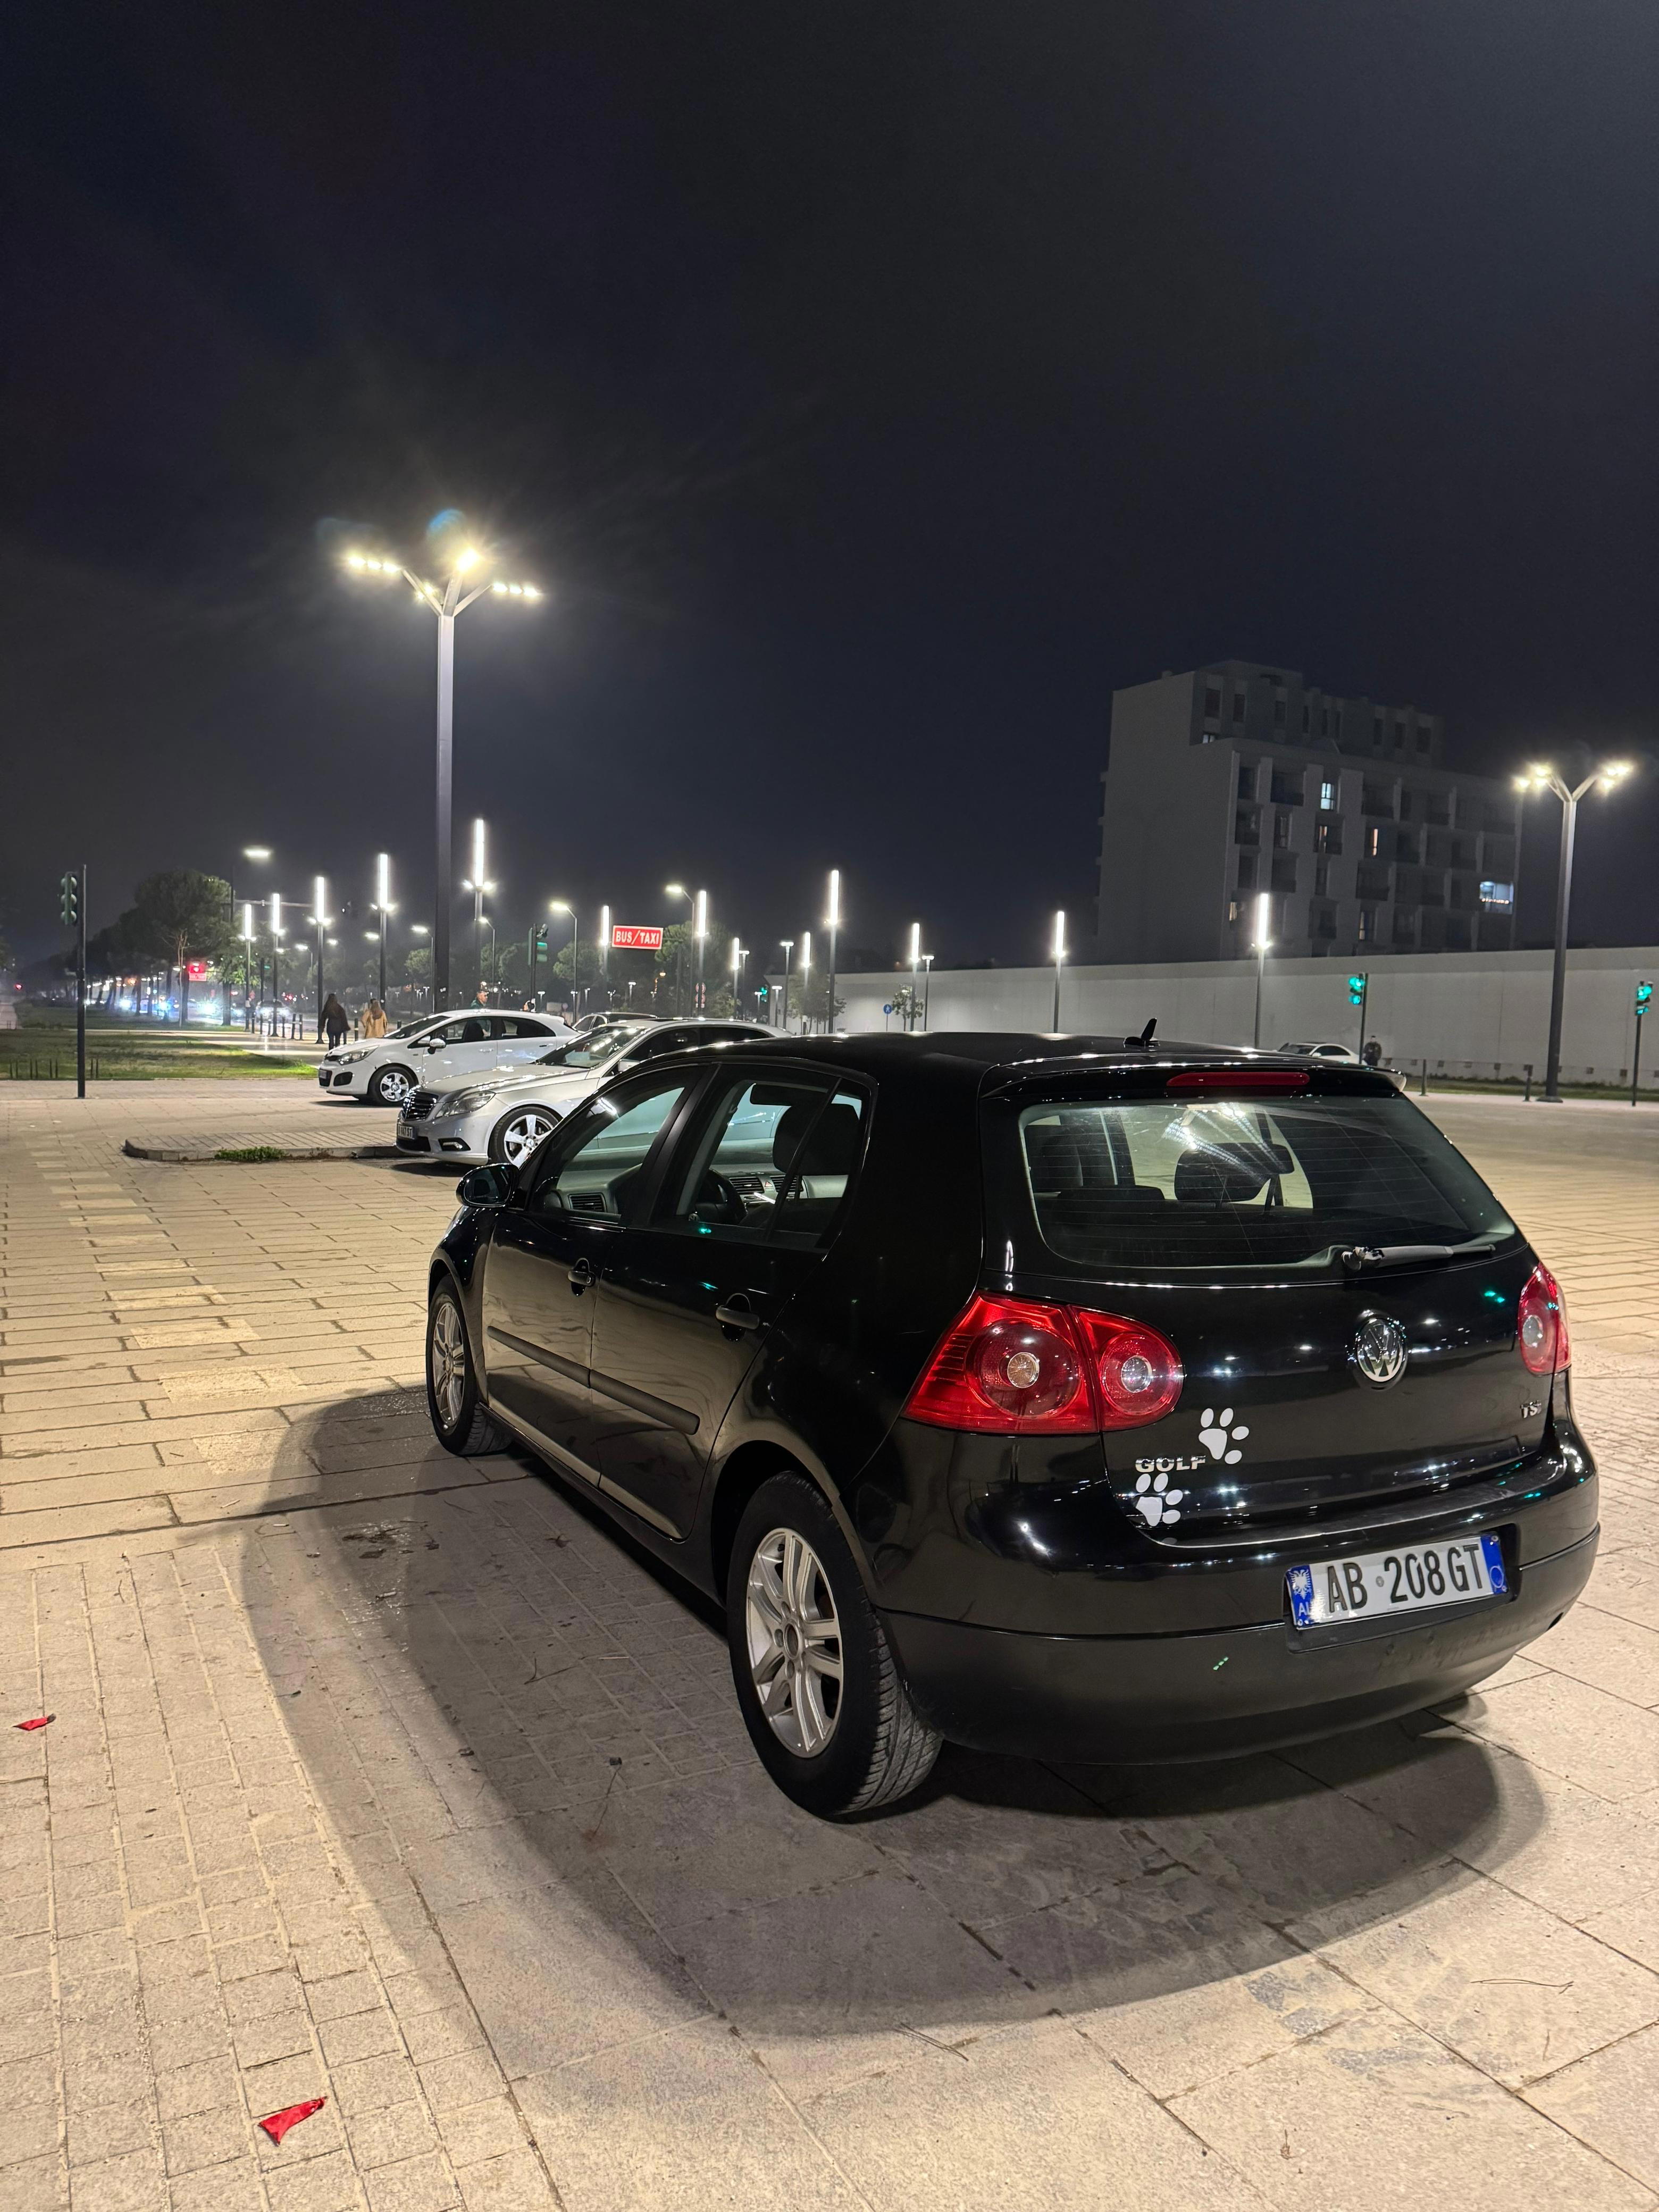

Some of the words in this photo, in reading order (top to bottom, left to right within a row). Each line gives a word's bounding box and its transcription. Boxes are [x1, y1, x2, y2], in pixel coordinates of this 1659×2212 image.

[616, 930, 659, 945] BUS/TAXI
[1135, 1455, 1206, 1472] GOLF
[1327, 1562, 1368, 1613] AB
